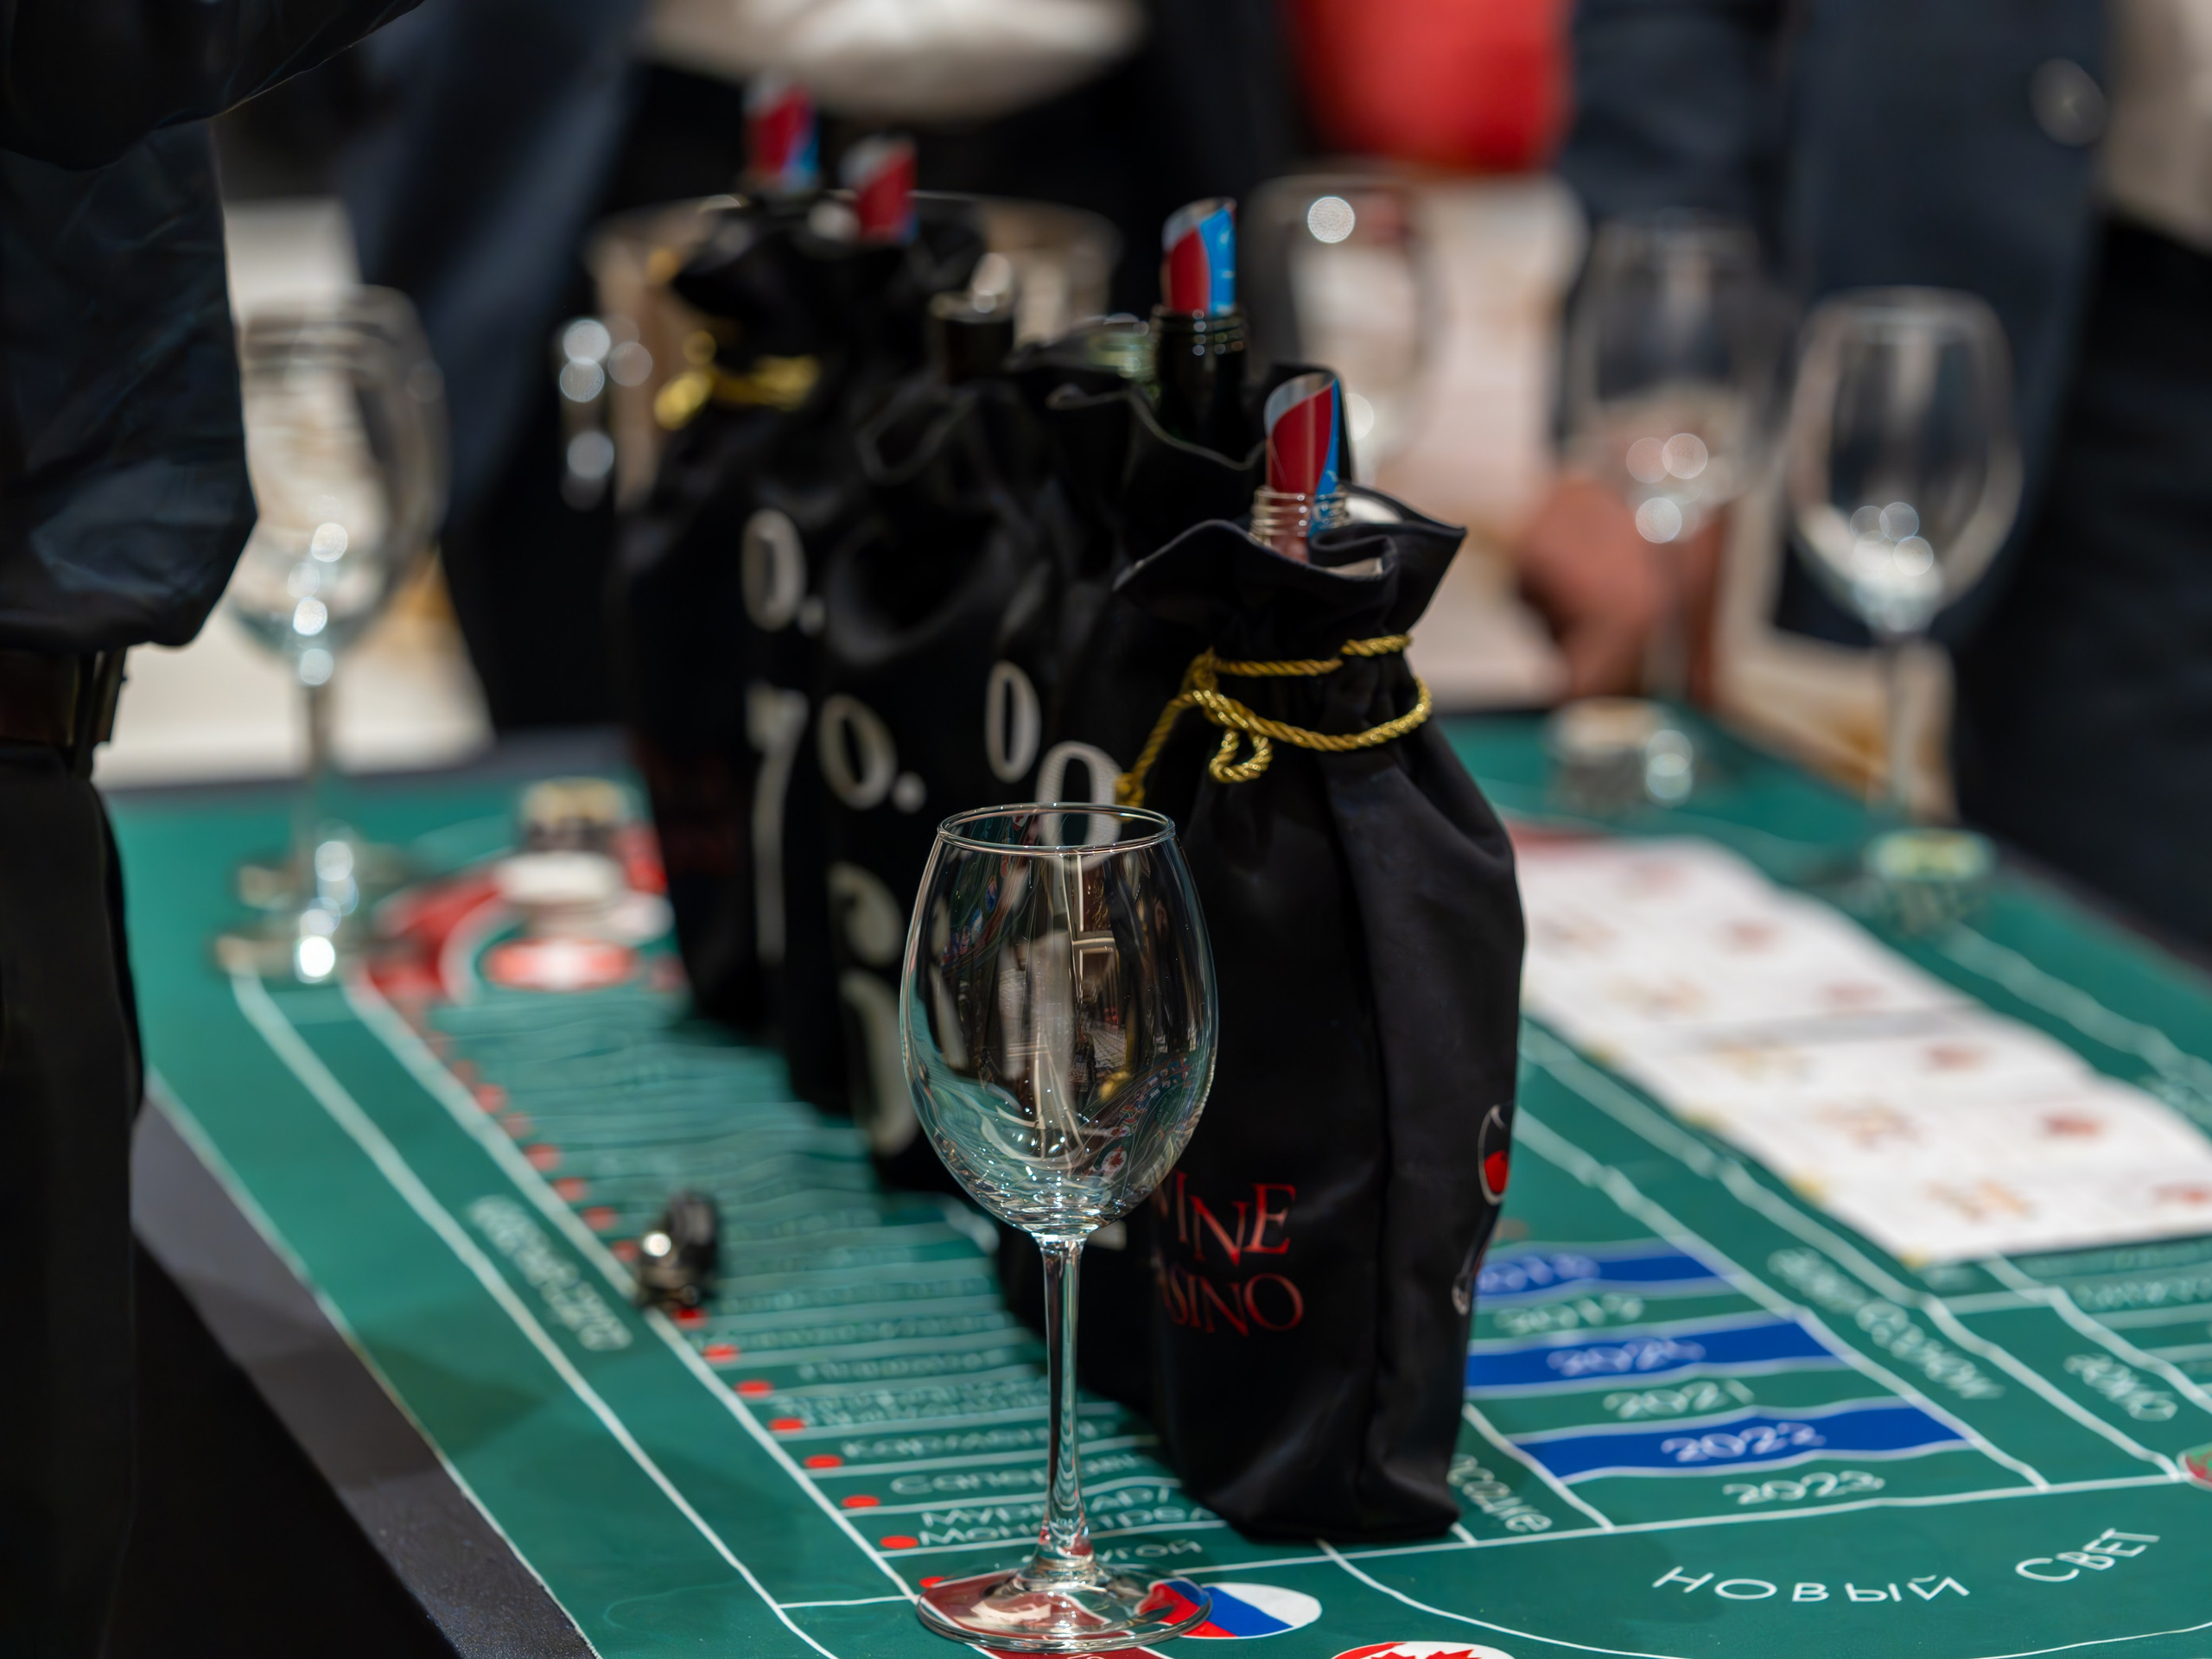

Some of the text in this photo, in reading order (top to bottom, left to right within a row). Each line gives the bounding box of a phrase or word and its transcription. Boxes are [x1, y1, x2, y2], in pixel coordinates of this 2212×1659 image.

[1158, 1262, 1304, 1337] SINO
[1603, 1380, 1754, 1420] 2021
[1661, 1421, 1826, 1463] 2022
[1723, 1470, 1886, 1506] 2023
[1652, 1528, 2161, 1603] НОВЫЙ СВЕТ
